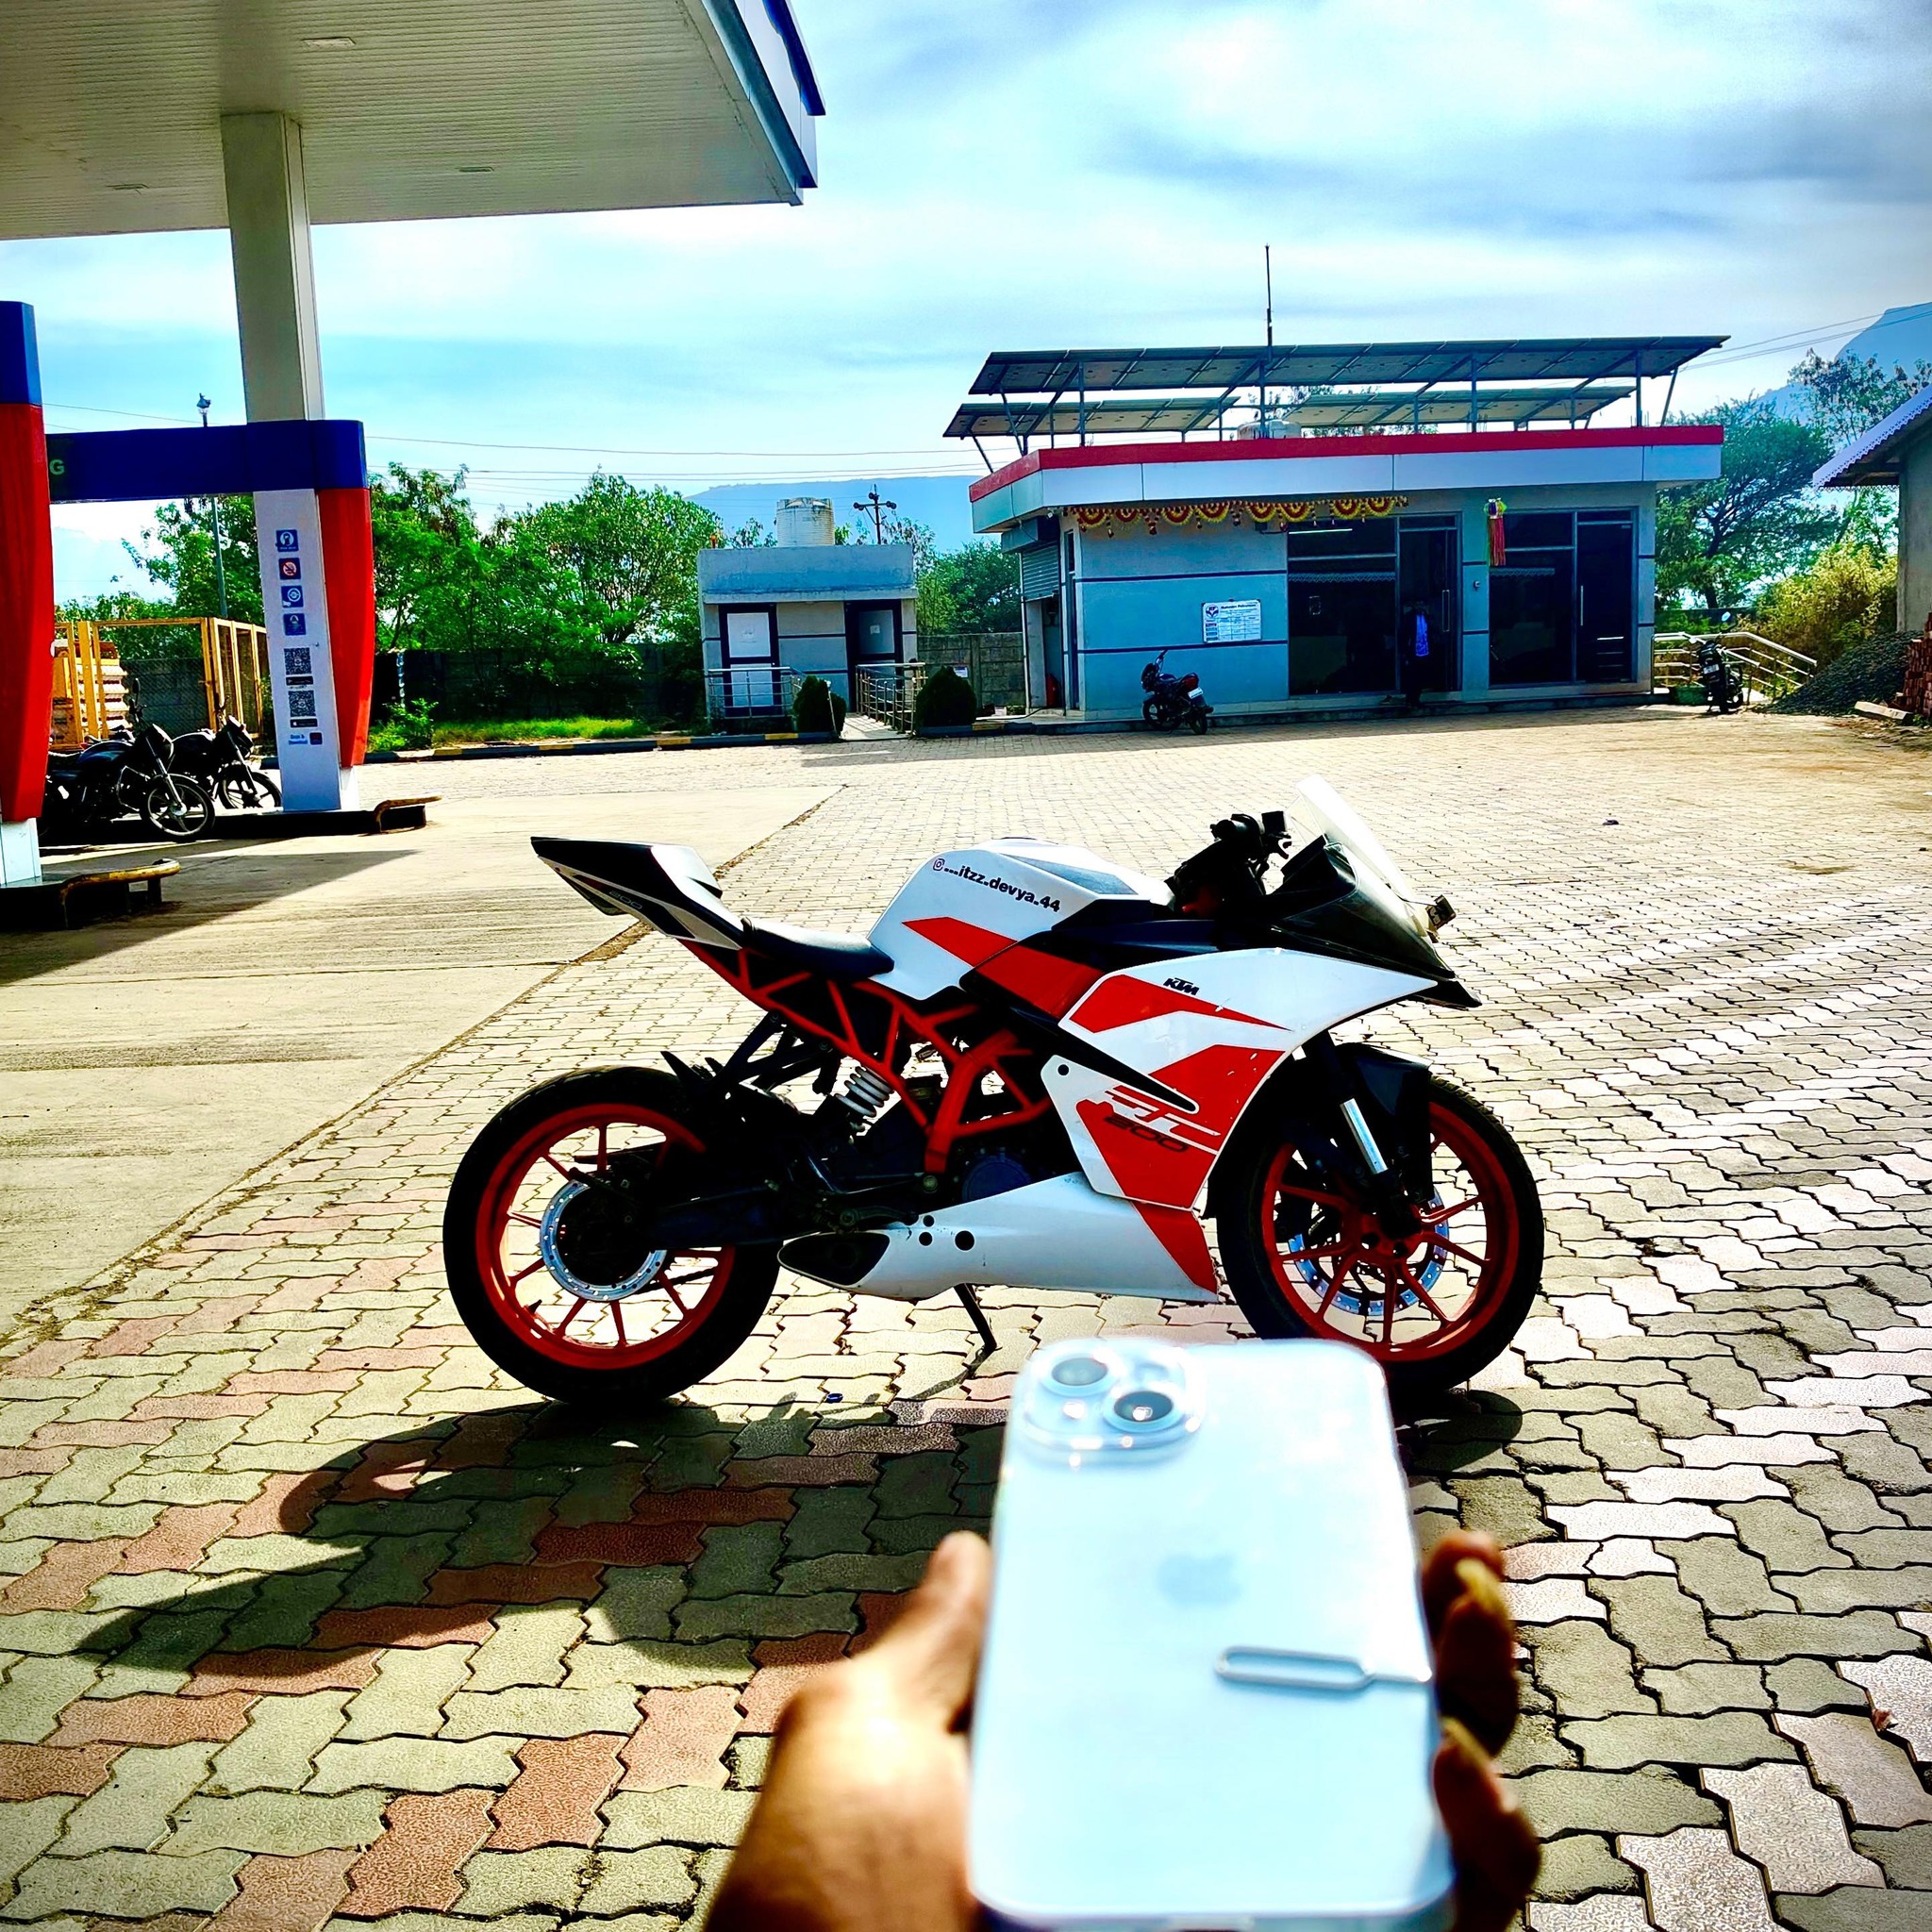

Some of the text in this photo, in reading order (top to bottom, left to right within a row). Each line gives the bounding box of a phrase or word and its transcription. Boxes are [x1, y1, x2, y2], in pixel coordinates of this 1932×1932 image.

[49, 458, 65, 475] G
[608, 891, 643, 910] 200
[1162, 977, 1200, 996] KTM
[1104, 1115, 1189, 1153] 200
